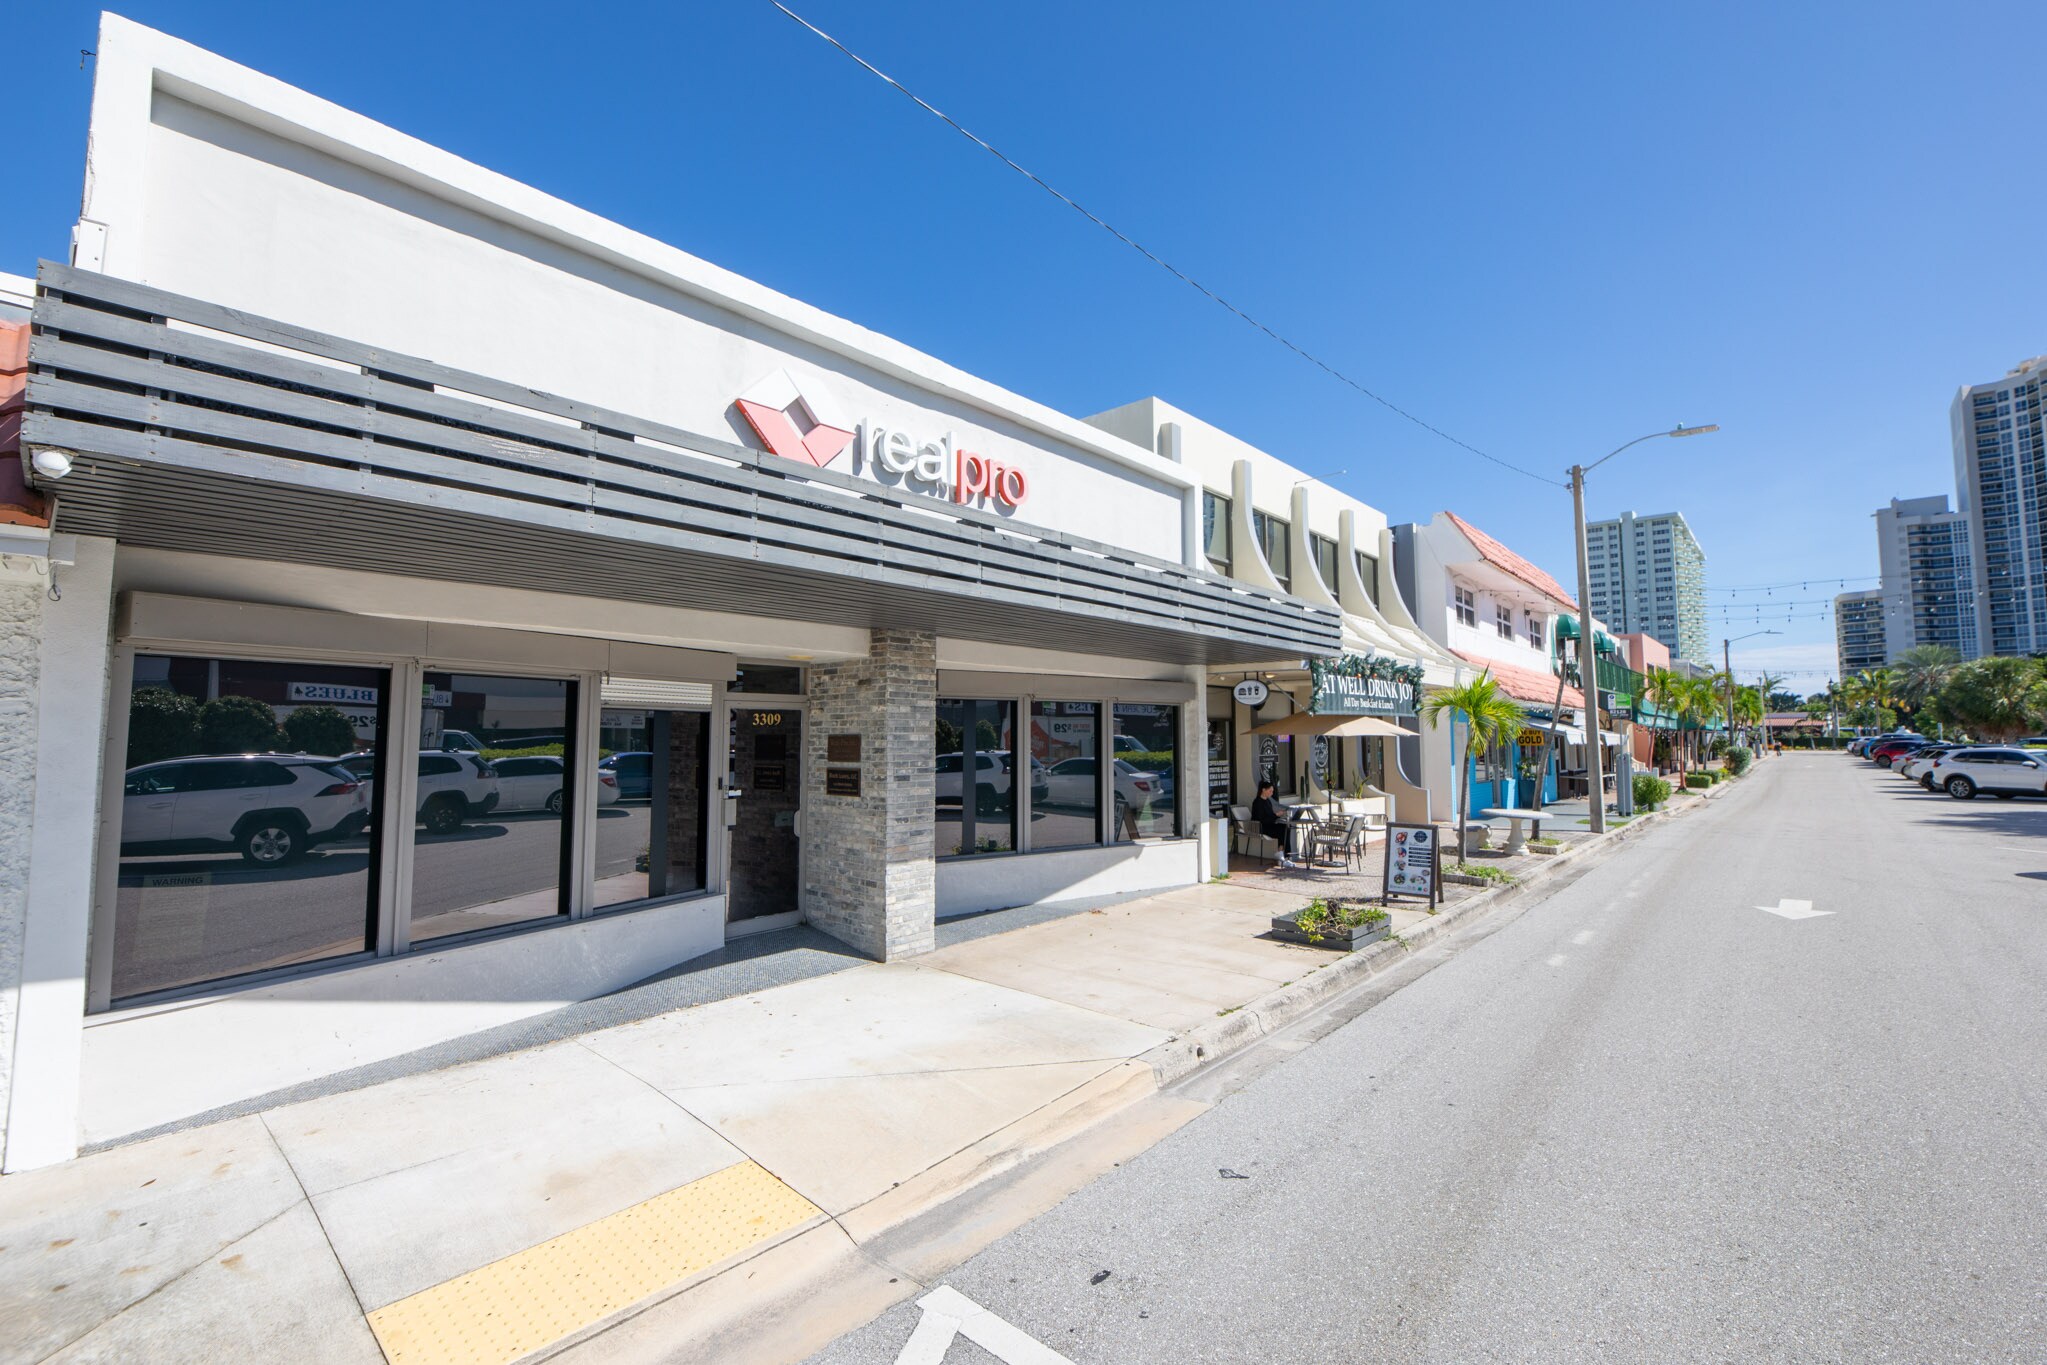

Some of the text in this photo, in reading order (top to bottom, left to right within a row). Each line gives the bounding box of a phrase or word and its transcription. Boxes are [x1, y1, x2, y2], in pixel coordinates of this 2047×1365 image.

[1337, 675, 1366, 696] WELL
[1367, 678, 1398, 700] DRINK
[1398, 682, 1414, 704] JOY
[752, 713, 781, 726] 3309
[1518, 735, 1542, 744] GOLD
[152, 876, 203, 887] WARNING
